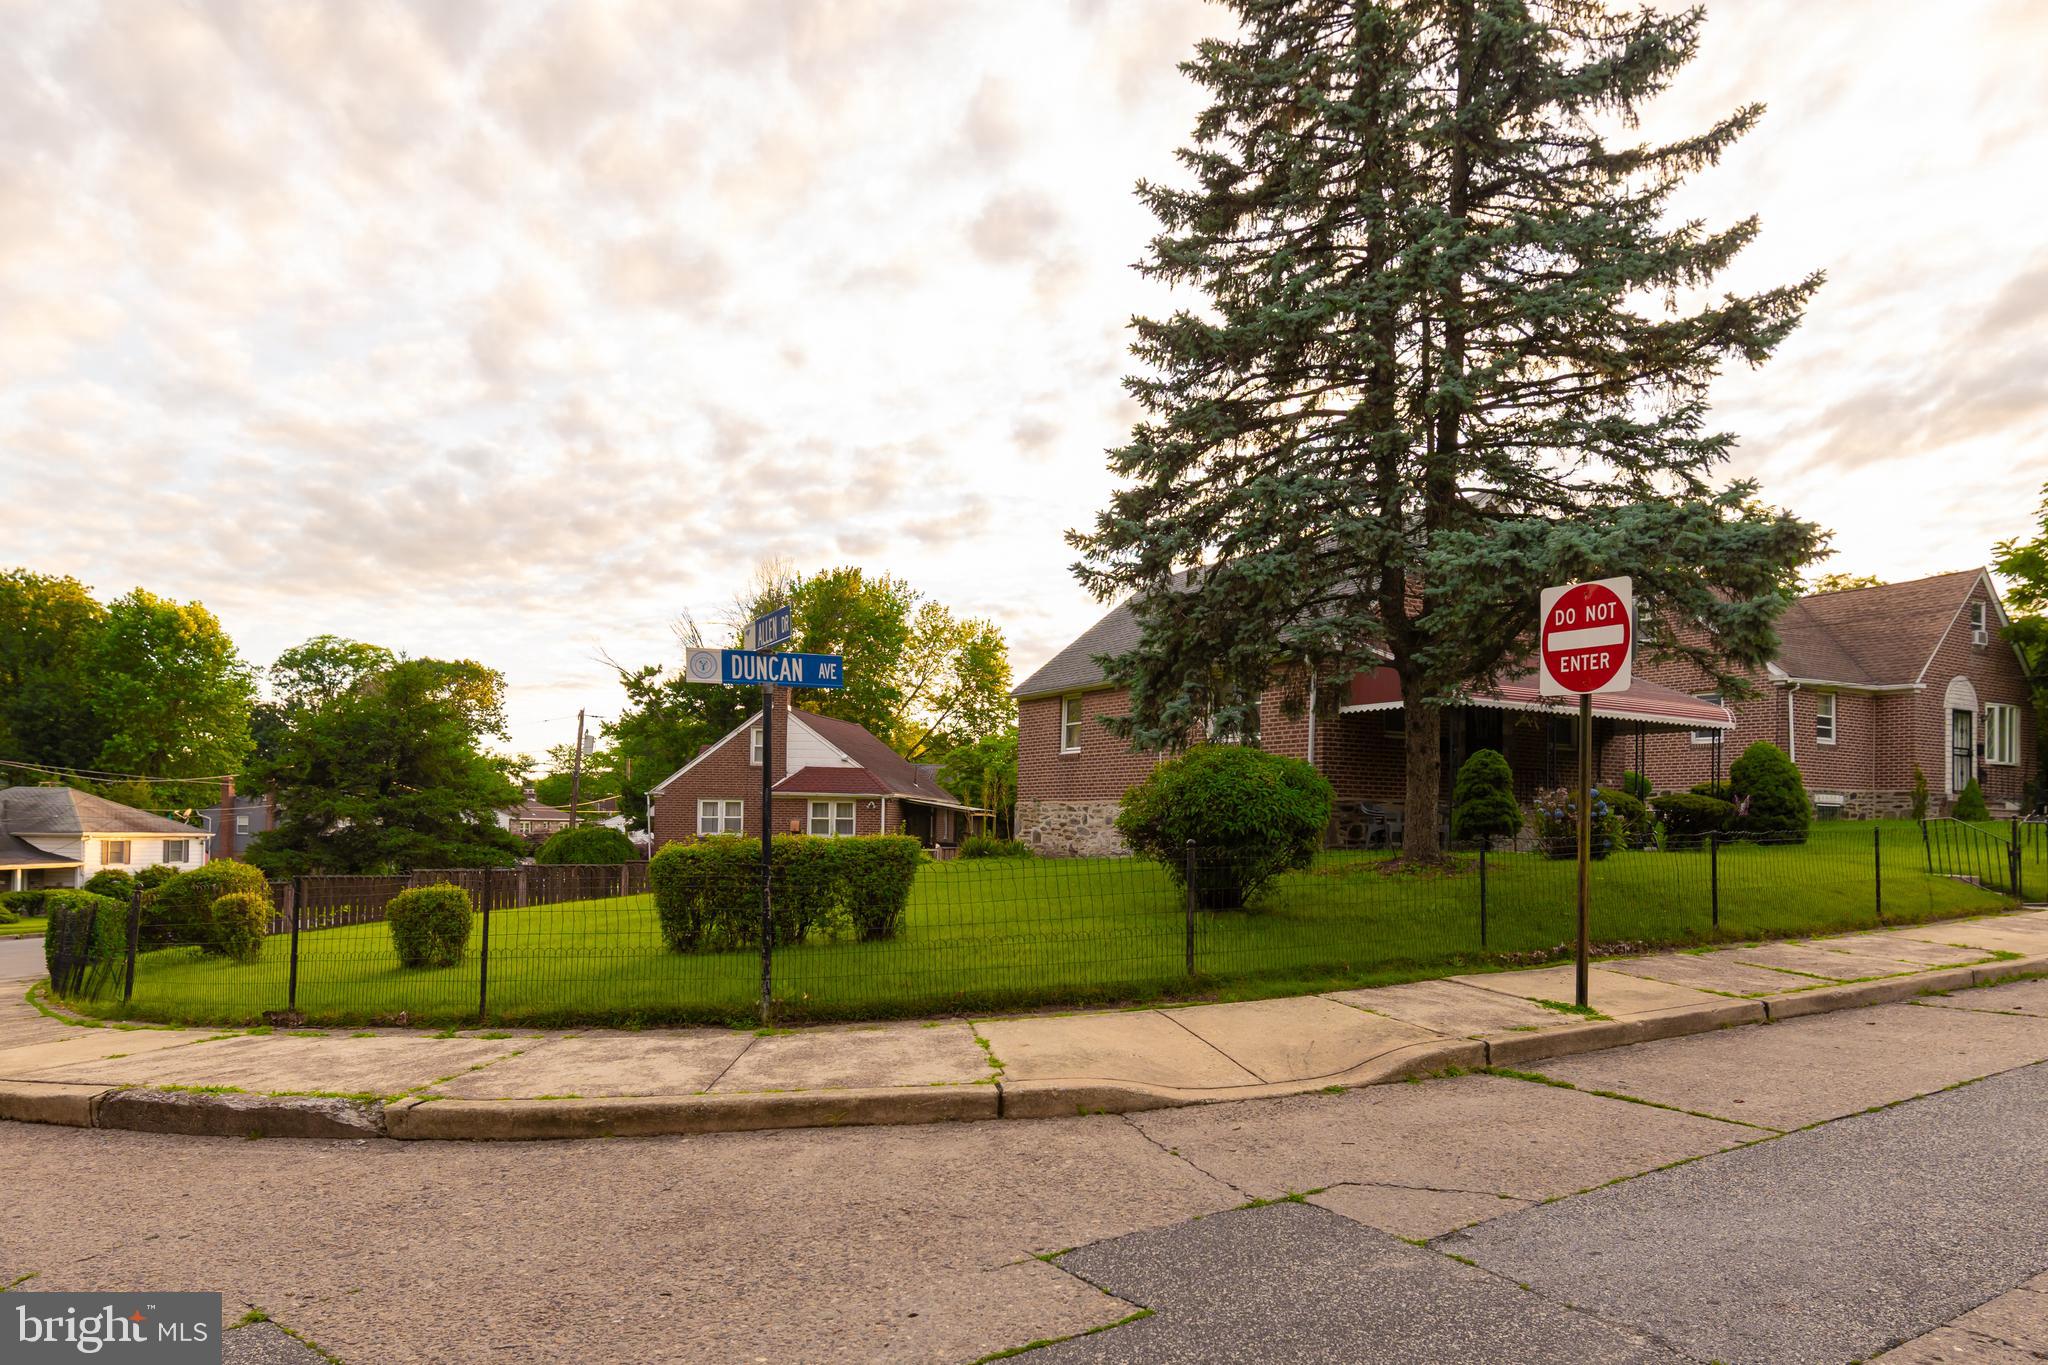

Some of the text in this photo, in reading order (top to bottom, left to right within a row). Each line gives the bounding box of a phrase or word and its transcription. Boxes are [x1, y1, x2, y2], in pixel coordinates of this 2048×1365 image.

[1555, 602, 1617, 626] DO NOT
[757, 614, 789, 647] ALLEN DR
[731, 655, 803, 682] DUNCAN
[818, 663, 837, 680] AVE
[1560, 652, 1610, 673] ENTER
